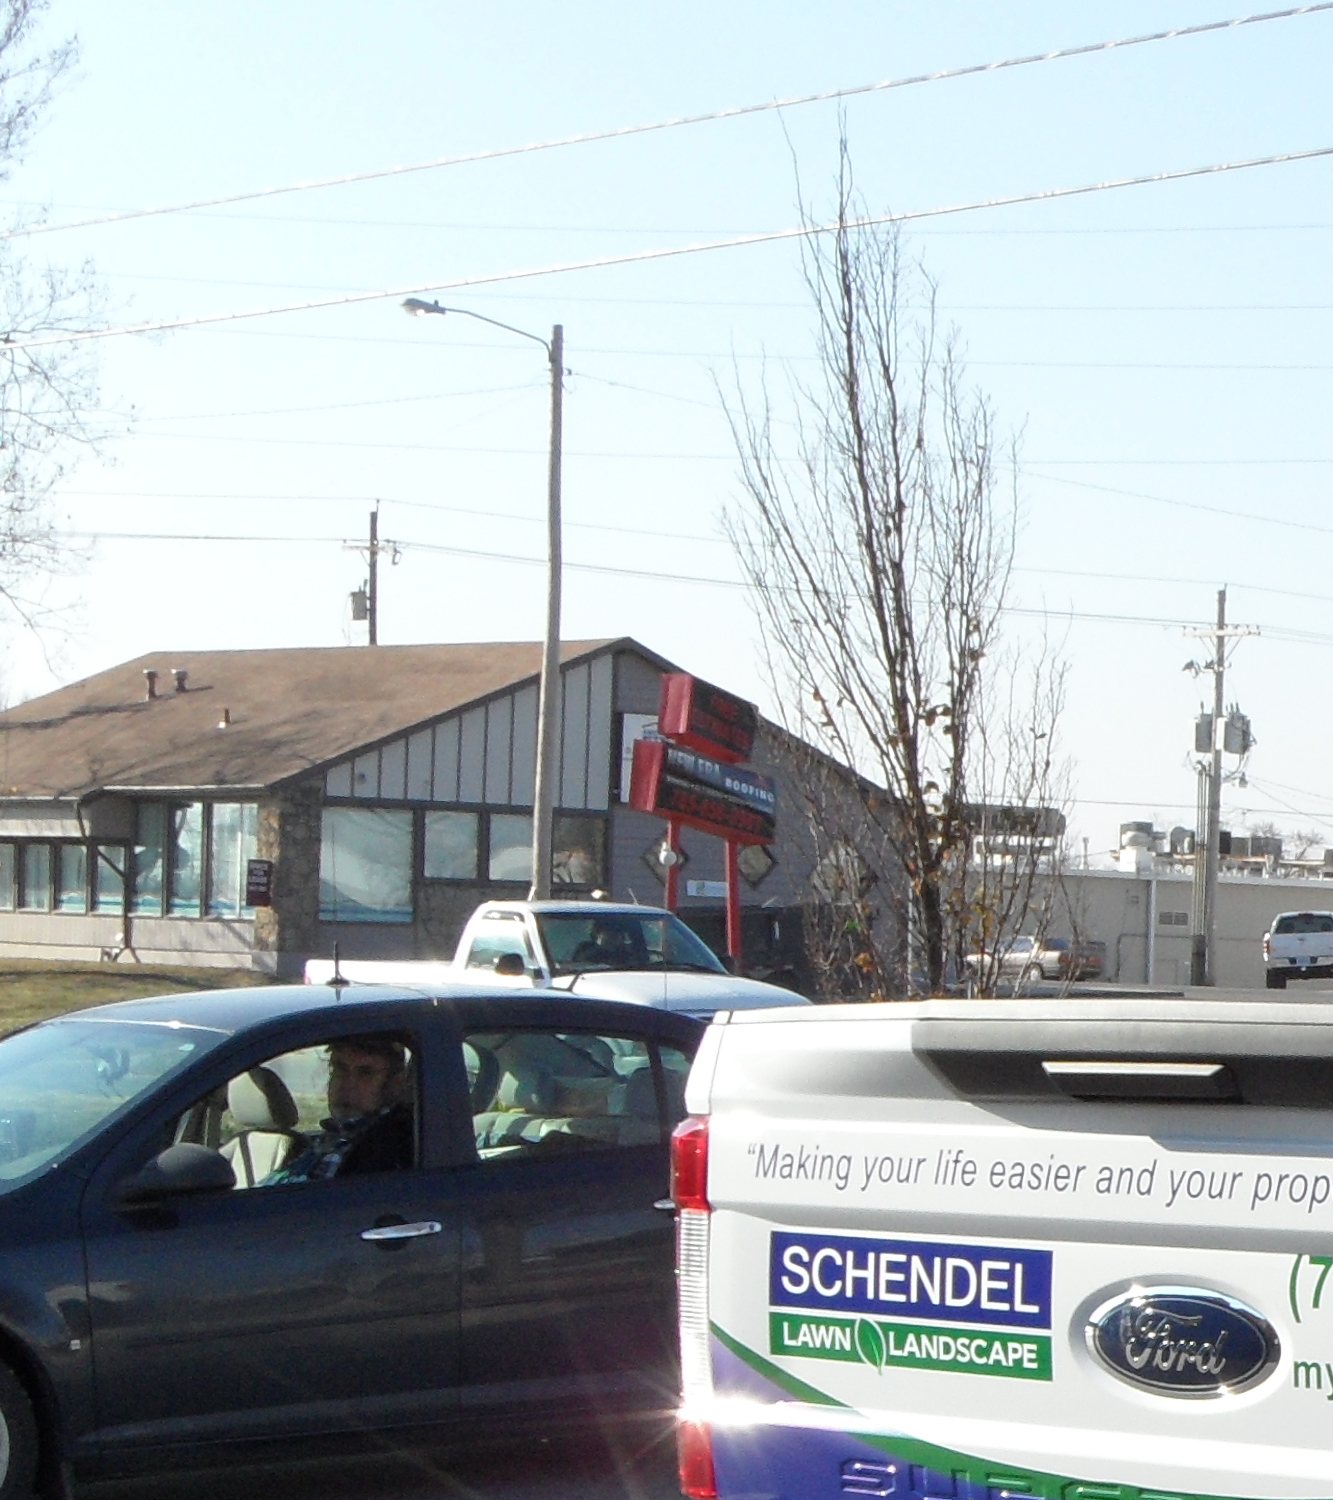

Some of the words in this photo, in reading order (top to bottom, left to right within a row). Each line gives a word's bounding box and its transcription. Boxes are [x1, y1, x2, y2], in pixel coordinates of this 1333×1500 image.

[724, 777, 776, 803] ROOFING
[861, 1151, 926, 1192] your
[934, 1148, 977, 1187] life
[989, 1154, 1086, 1193] easier
[1096, 1158, 1157, 1197] and
[1165, 1165, 1243, 1207] your
[781, 1245, 1040, 1314] SCHENDEL
[782, 1321, 851, 1352] LAWN
[889, 1331, 1039, 1370] LANDSCAPE
[1125, 1306, 1228, 1375] Ford
